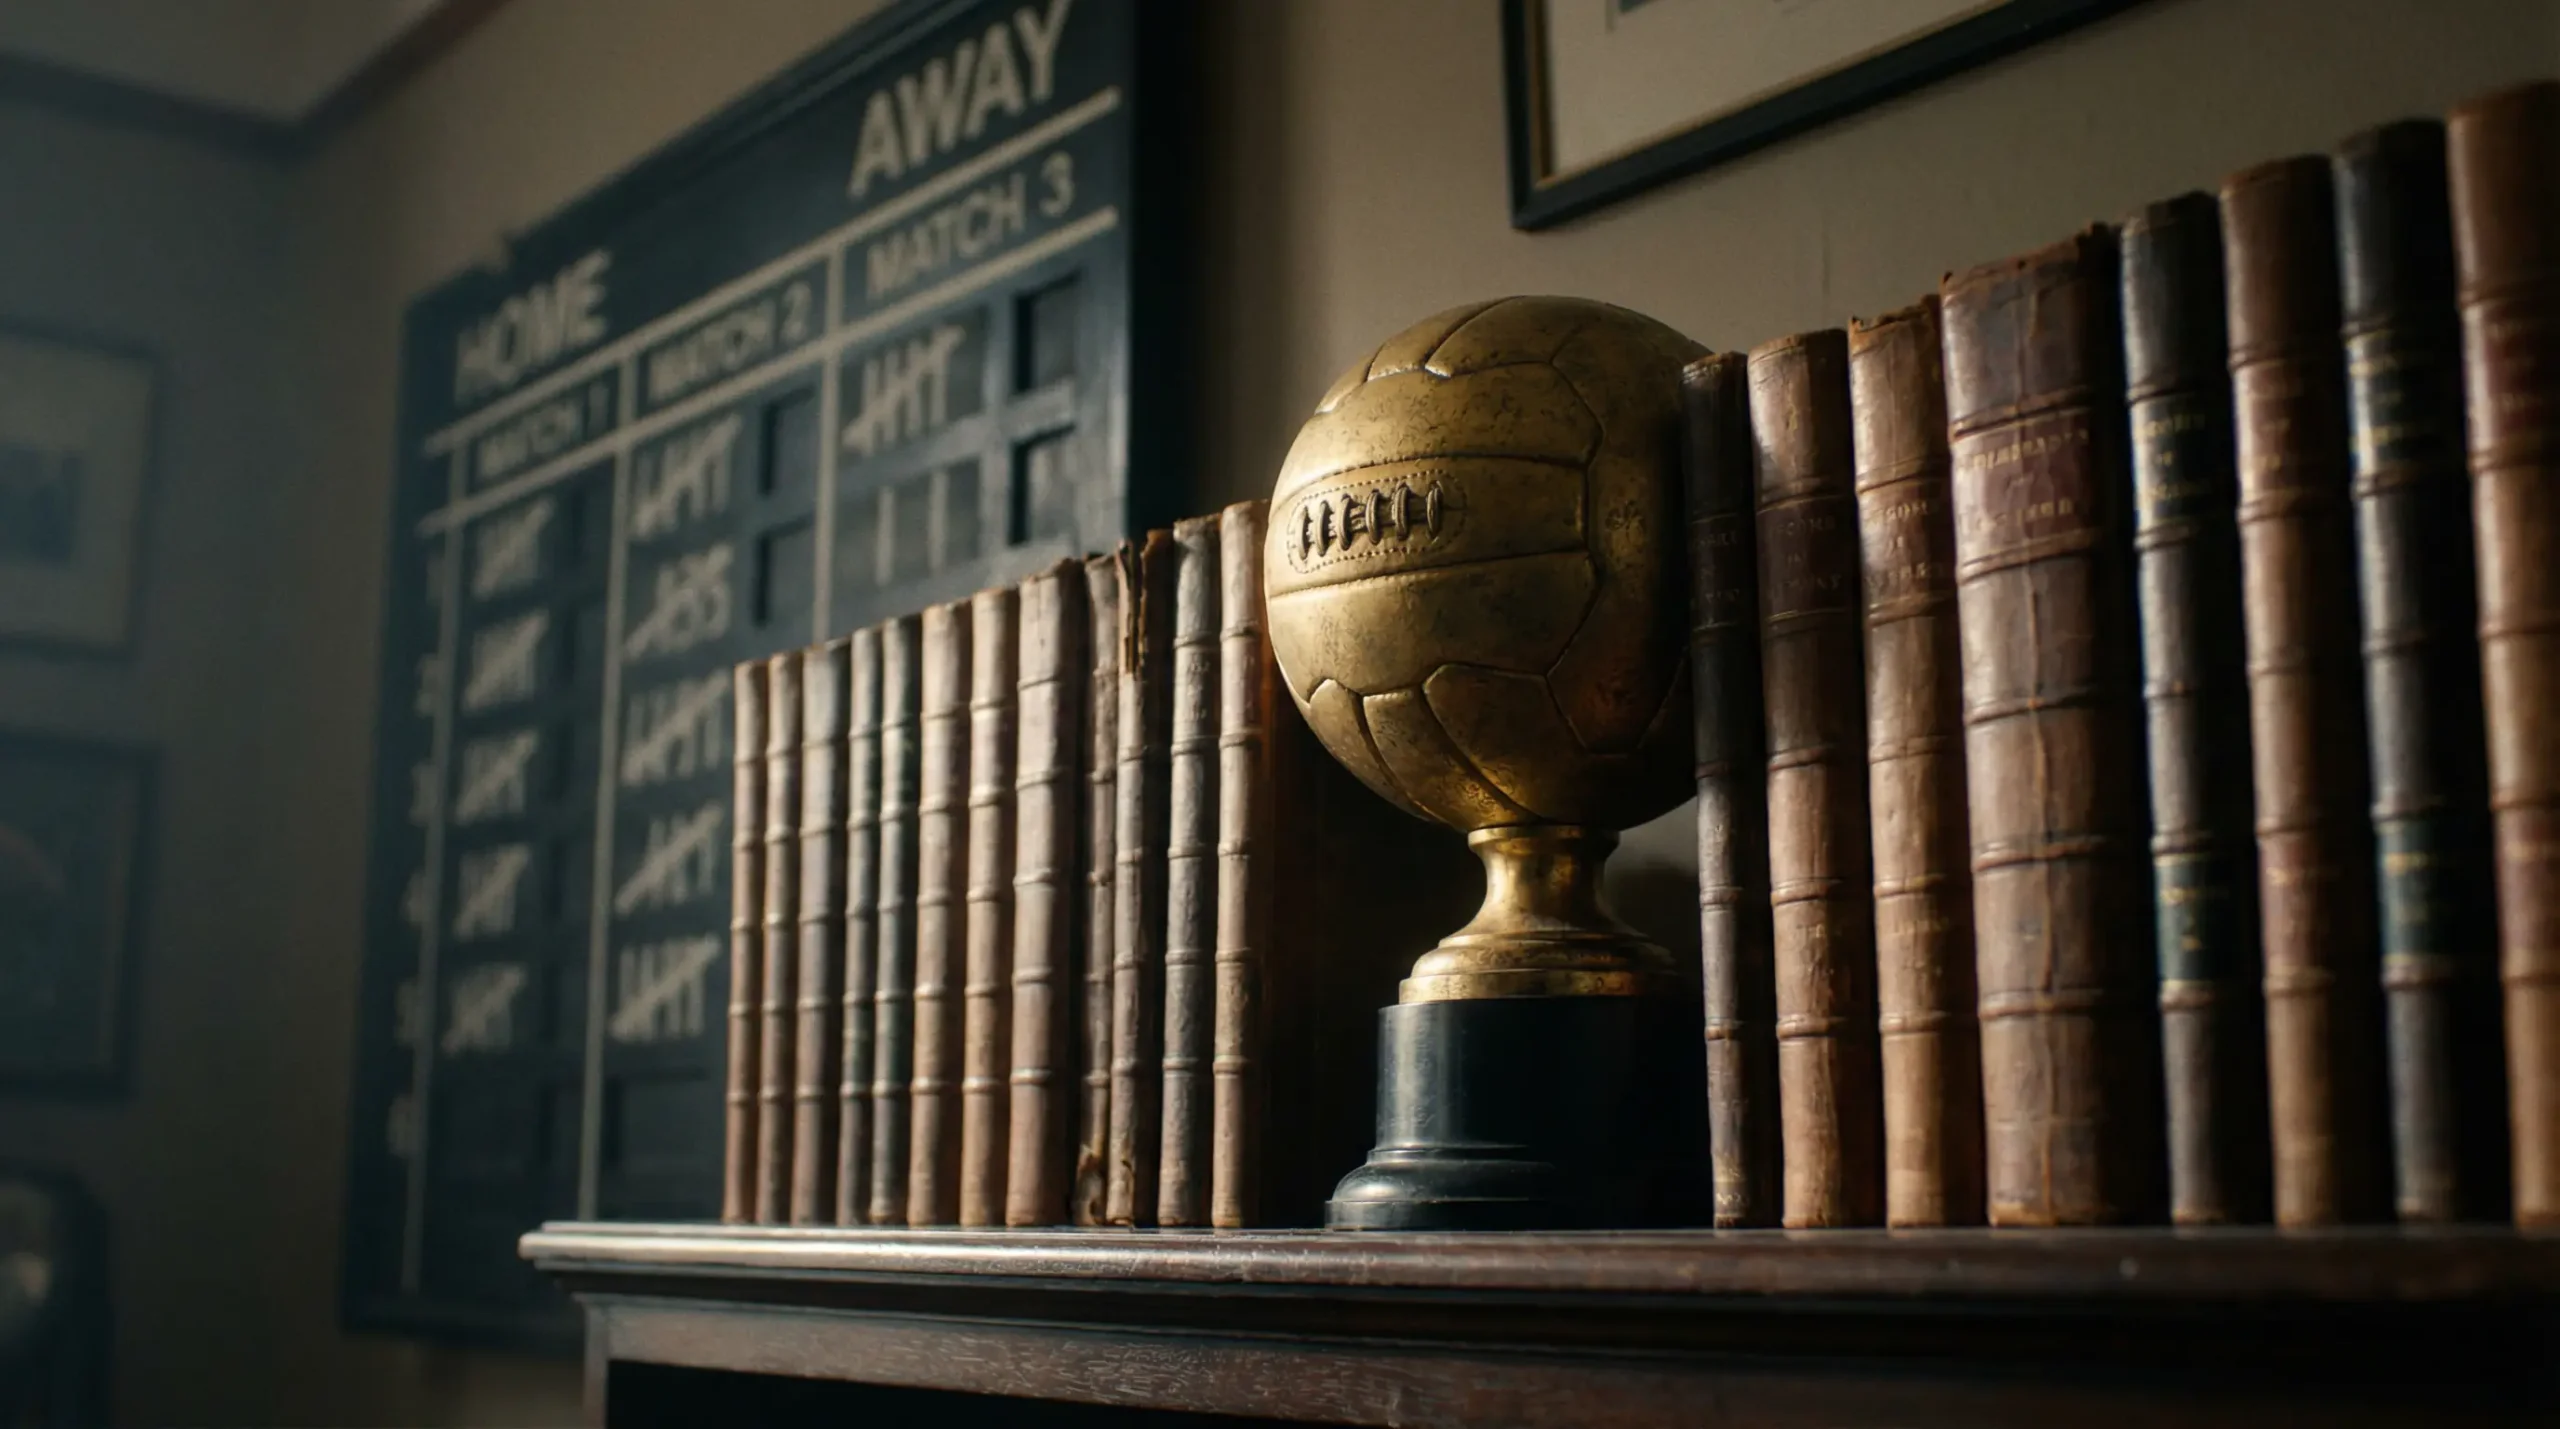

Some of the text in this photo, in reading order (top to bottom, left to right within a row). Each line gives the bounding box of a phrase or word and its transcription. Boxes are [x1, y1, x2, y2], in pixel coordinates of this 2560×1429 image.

[849, 0, 1071, 195] AWAY
[866, 149, 1076, 300] MATCH 3
[454, 248, 614, 404] HOME
[647, 280, 812, 403] MATCH 2
